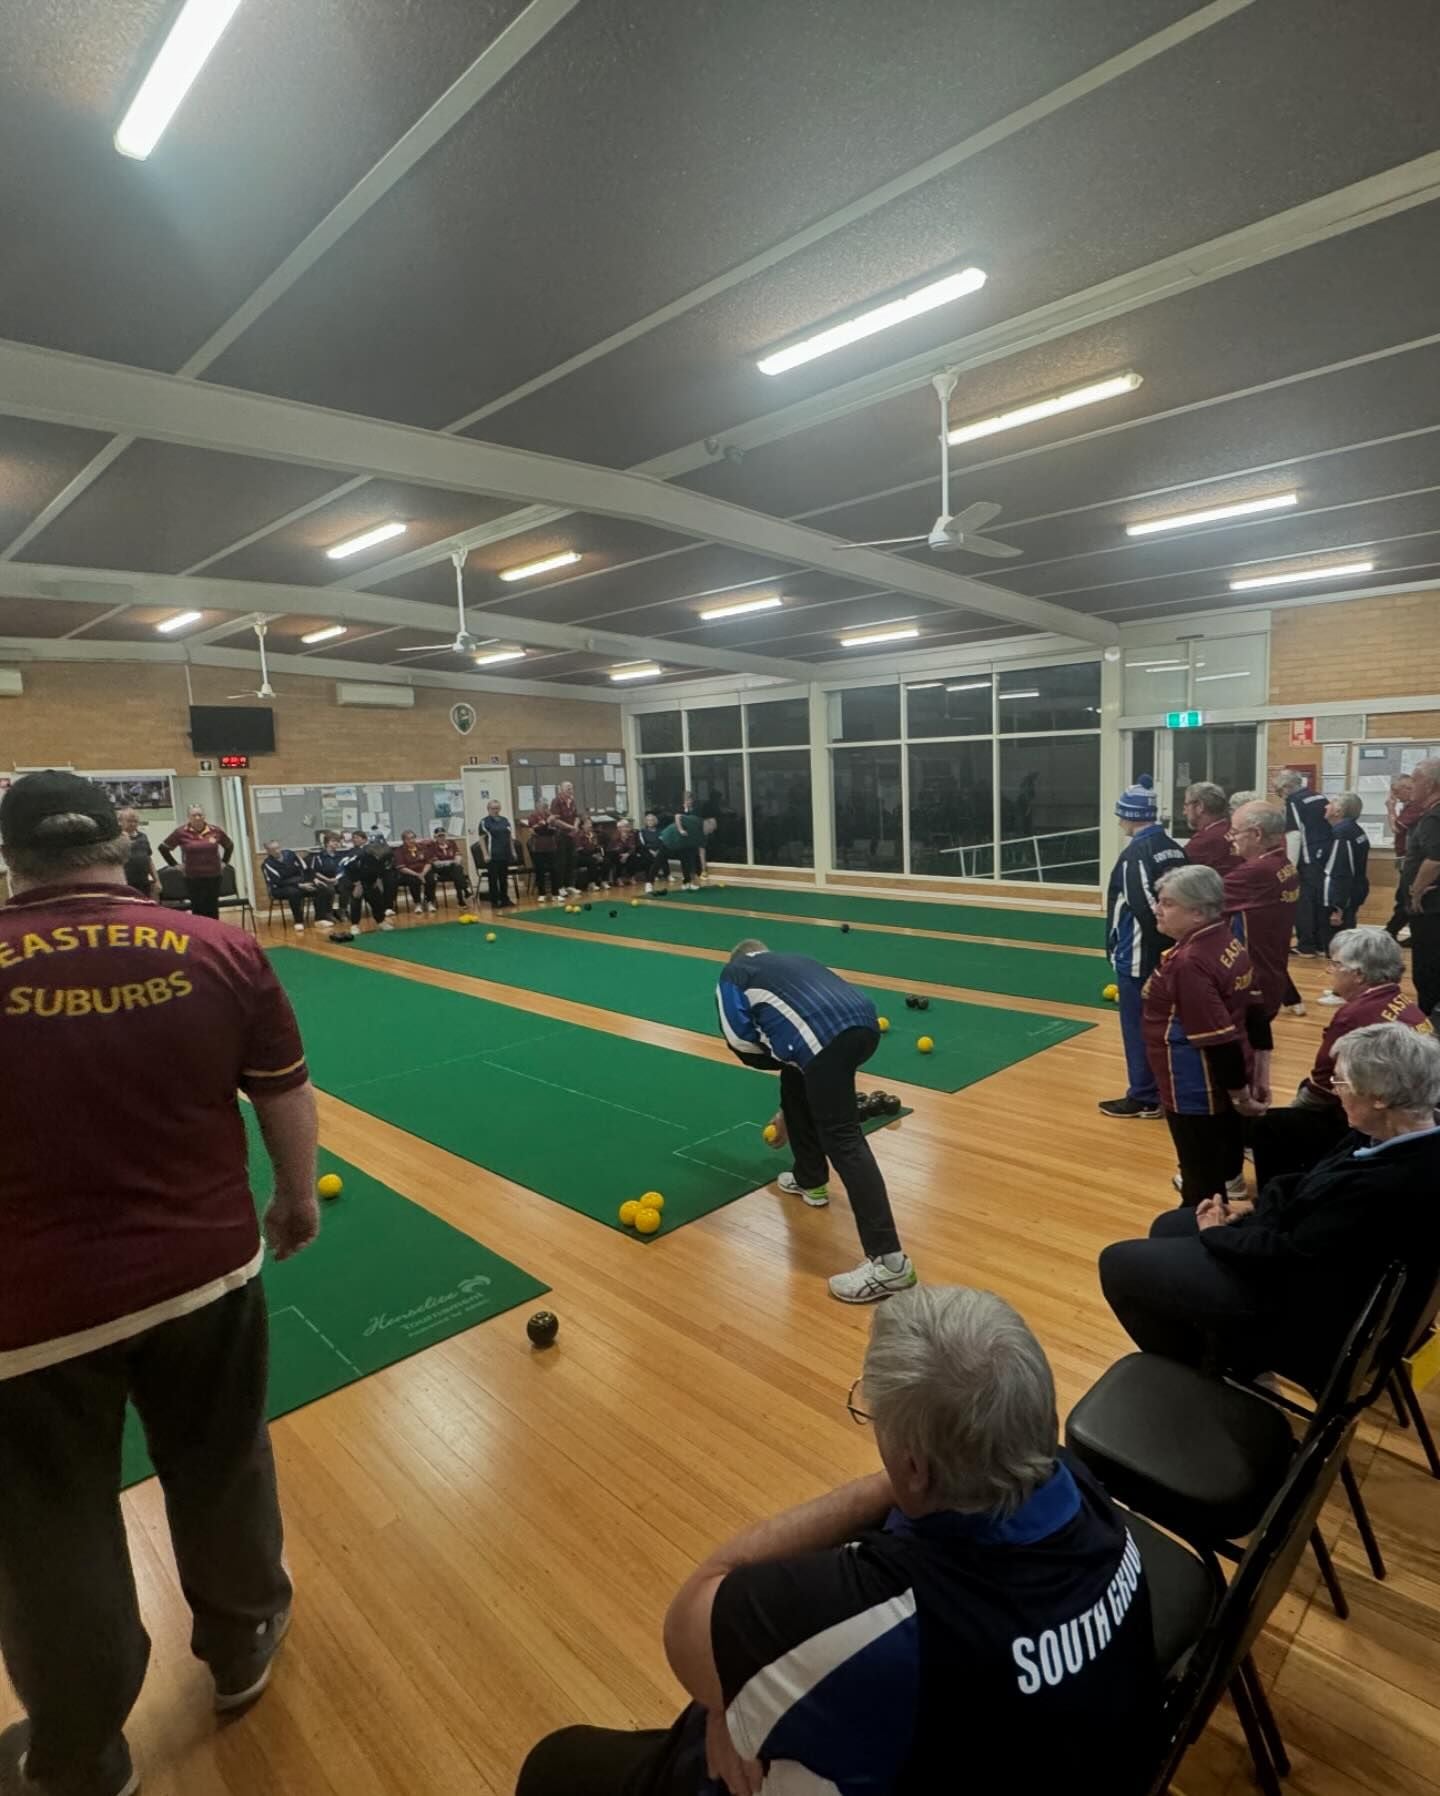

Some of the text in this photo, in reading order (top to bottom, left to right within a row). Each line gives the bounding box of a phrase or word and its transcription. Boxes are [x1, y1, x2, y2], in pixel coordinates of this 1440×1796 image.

[0, 924, 191, 968] EASTERN
[5, 970, 193, 1017] SUBURBS
[1011, 1525, 1142, 1696] SOUTH GROU
